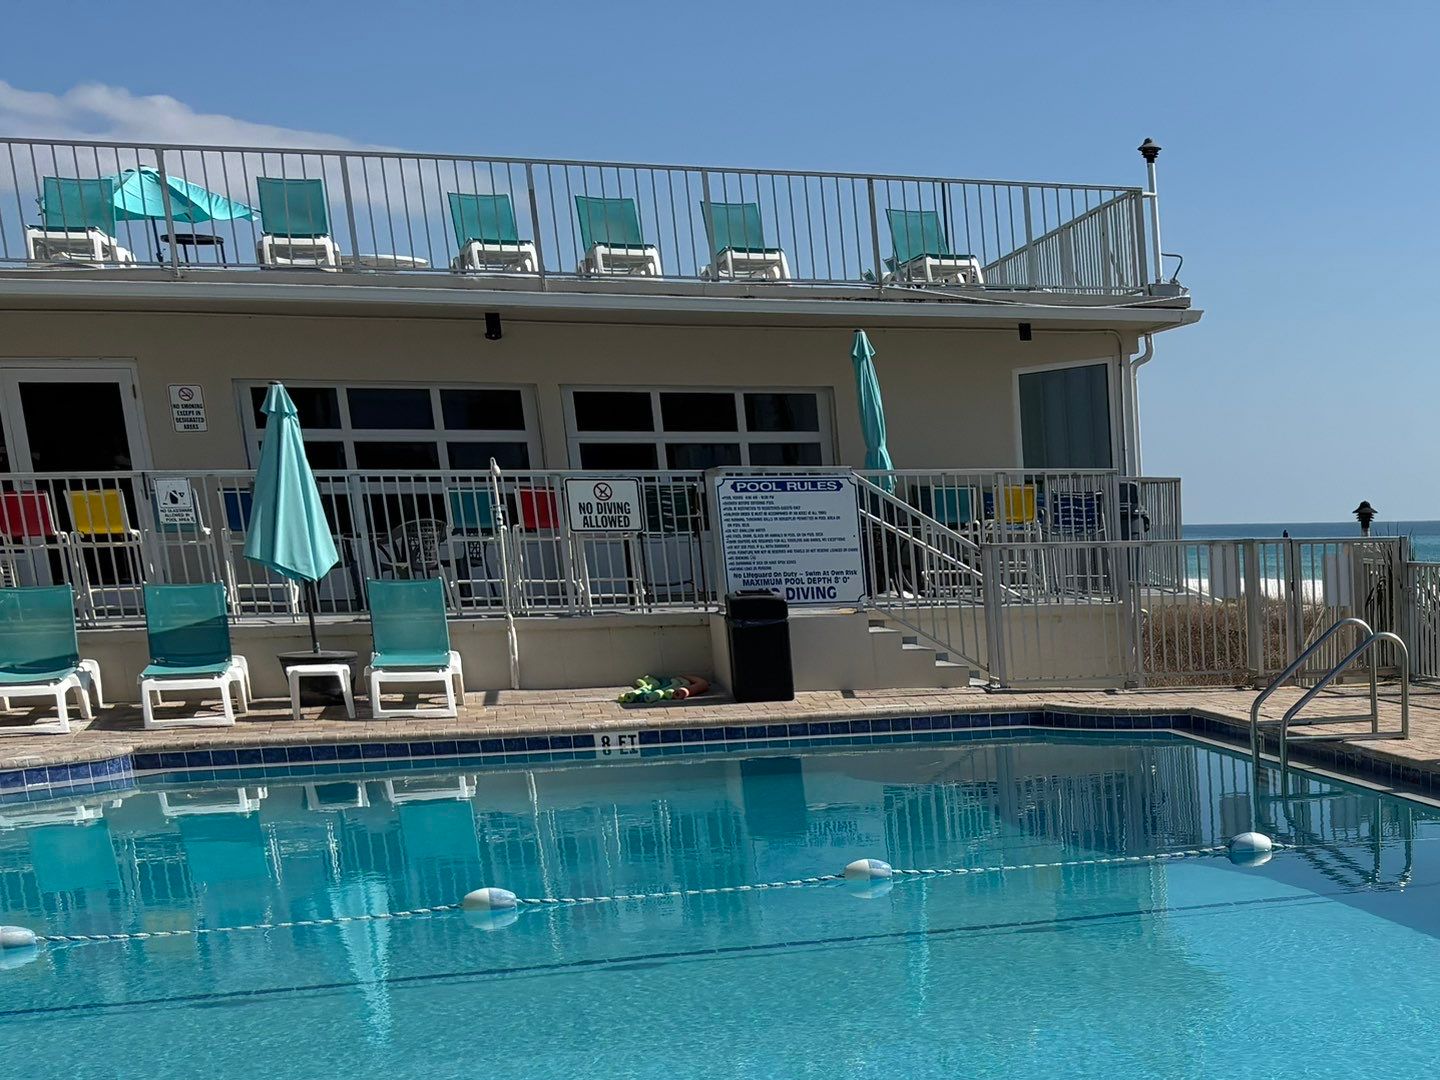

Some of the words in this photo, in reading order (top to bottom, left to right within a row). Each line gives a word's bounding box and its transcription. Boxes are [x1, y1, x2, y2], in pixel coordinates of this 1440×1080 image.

[736, 481, 782, 492] POOL
[787, 481, 838, 491] RULES
[578, 502, 593, 515] NO
[596, 502, 631, 515] DIVING
[583, 515, 631, 528] ALLOWED
[742, 578, 783, 586] MAXIMUM
[784, 577, 805, 585] POOL
[807, 577, 832, 585] DEPTH
[785, 586, 837, 600] DIVING
[601, 735, 611, 747] 8
[618, 734, 637, 747] FT
